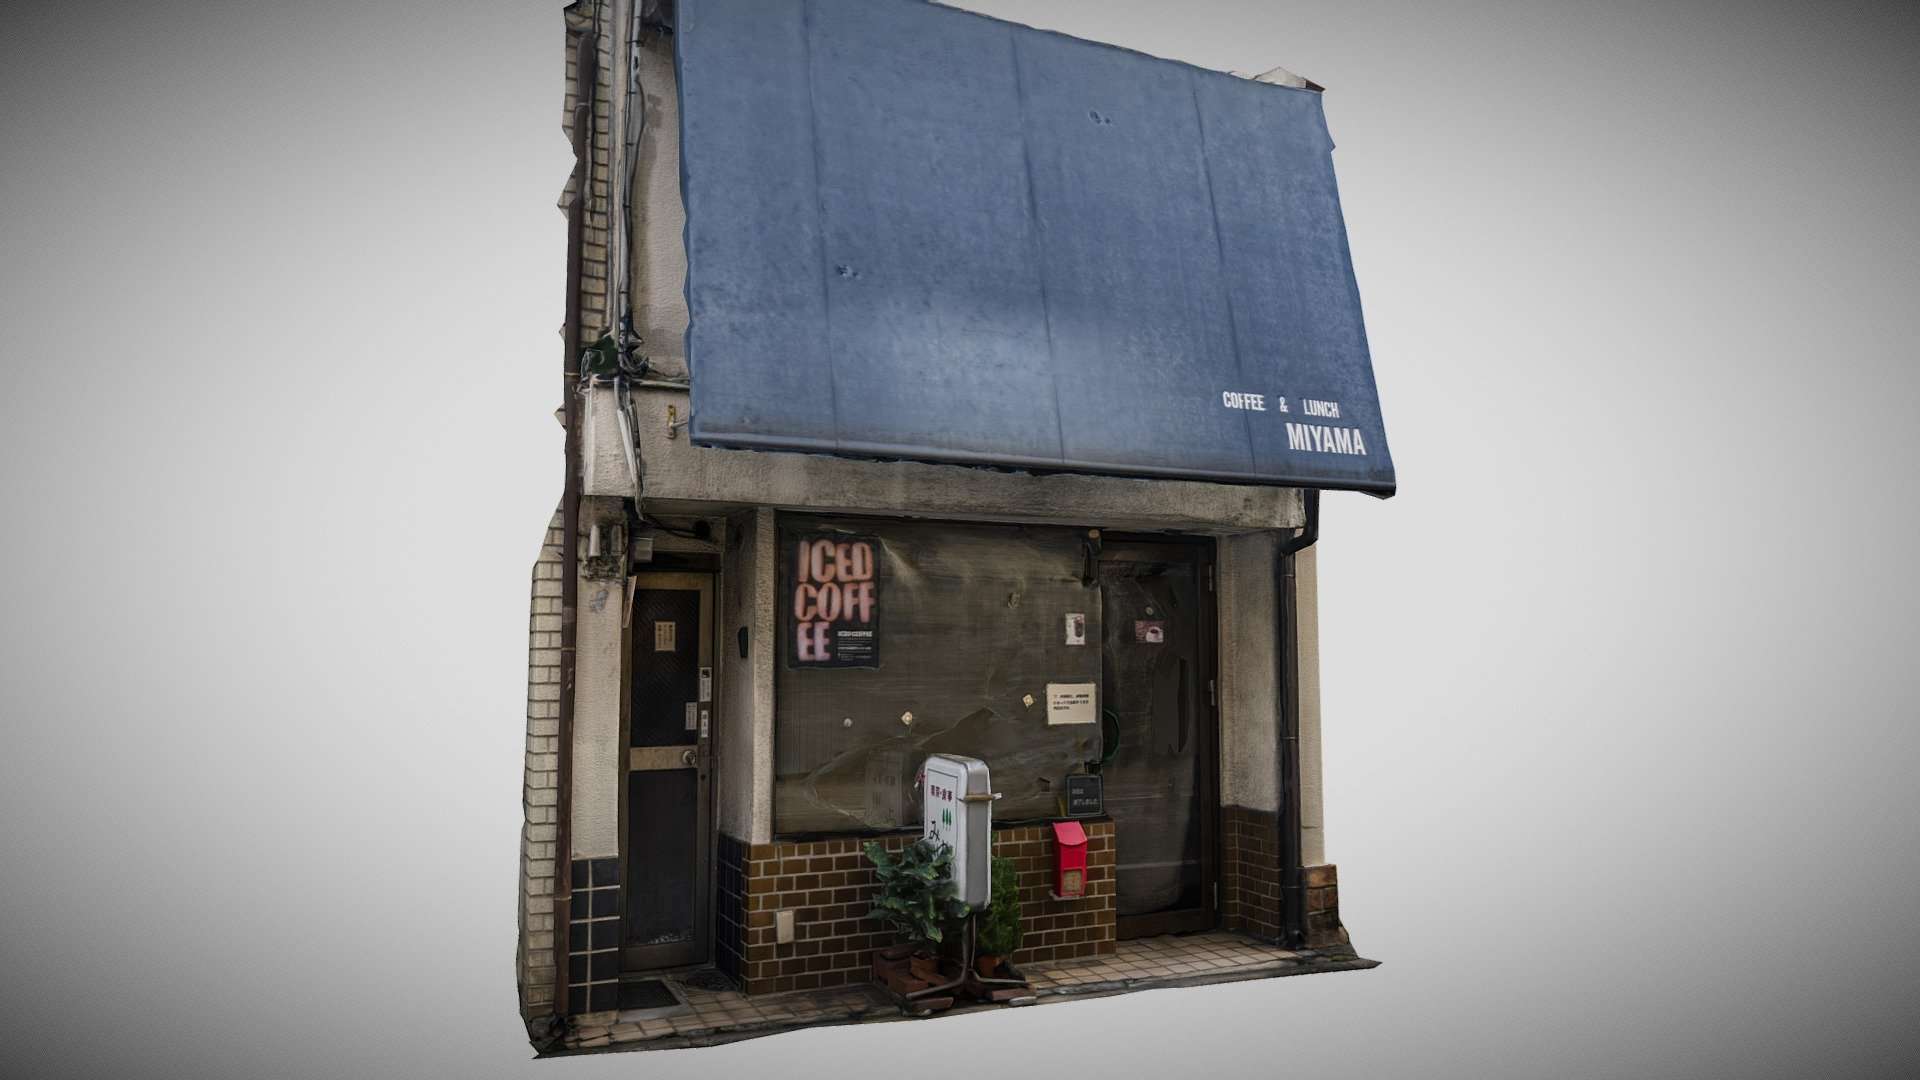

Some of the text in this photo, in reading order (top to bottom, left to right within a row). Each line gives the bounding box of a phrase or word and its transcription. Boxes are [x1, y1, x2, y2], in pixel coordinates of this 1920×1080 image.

[1222, 391, 1340, 418] COFFEE & LUNCH
[1286, 422, 1367, 456] MIYAMA
[797, 539, 874, 583] ICED
[794, 582, 877, 623] COFF
[796, 621, 831, 662] EE
